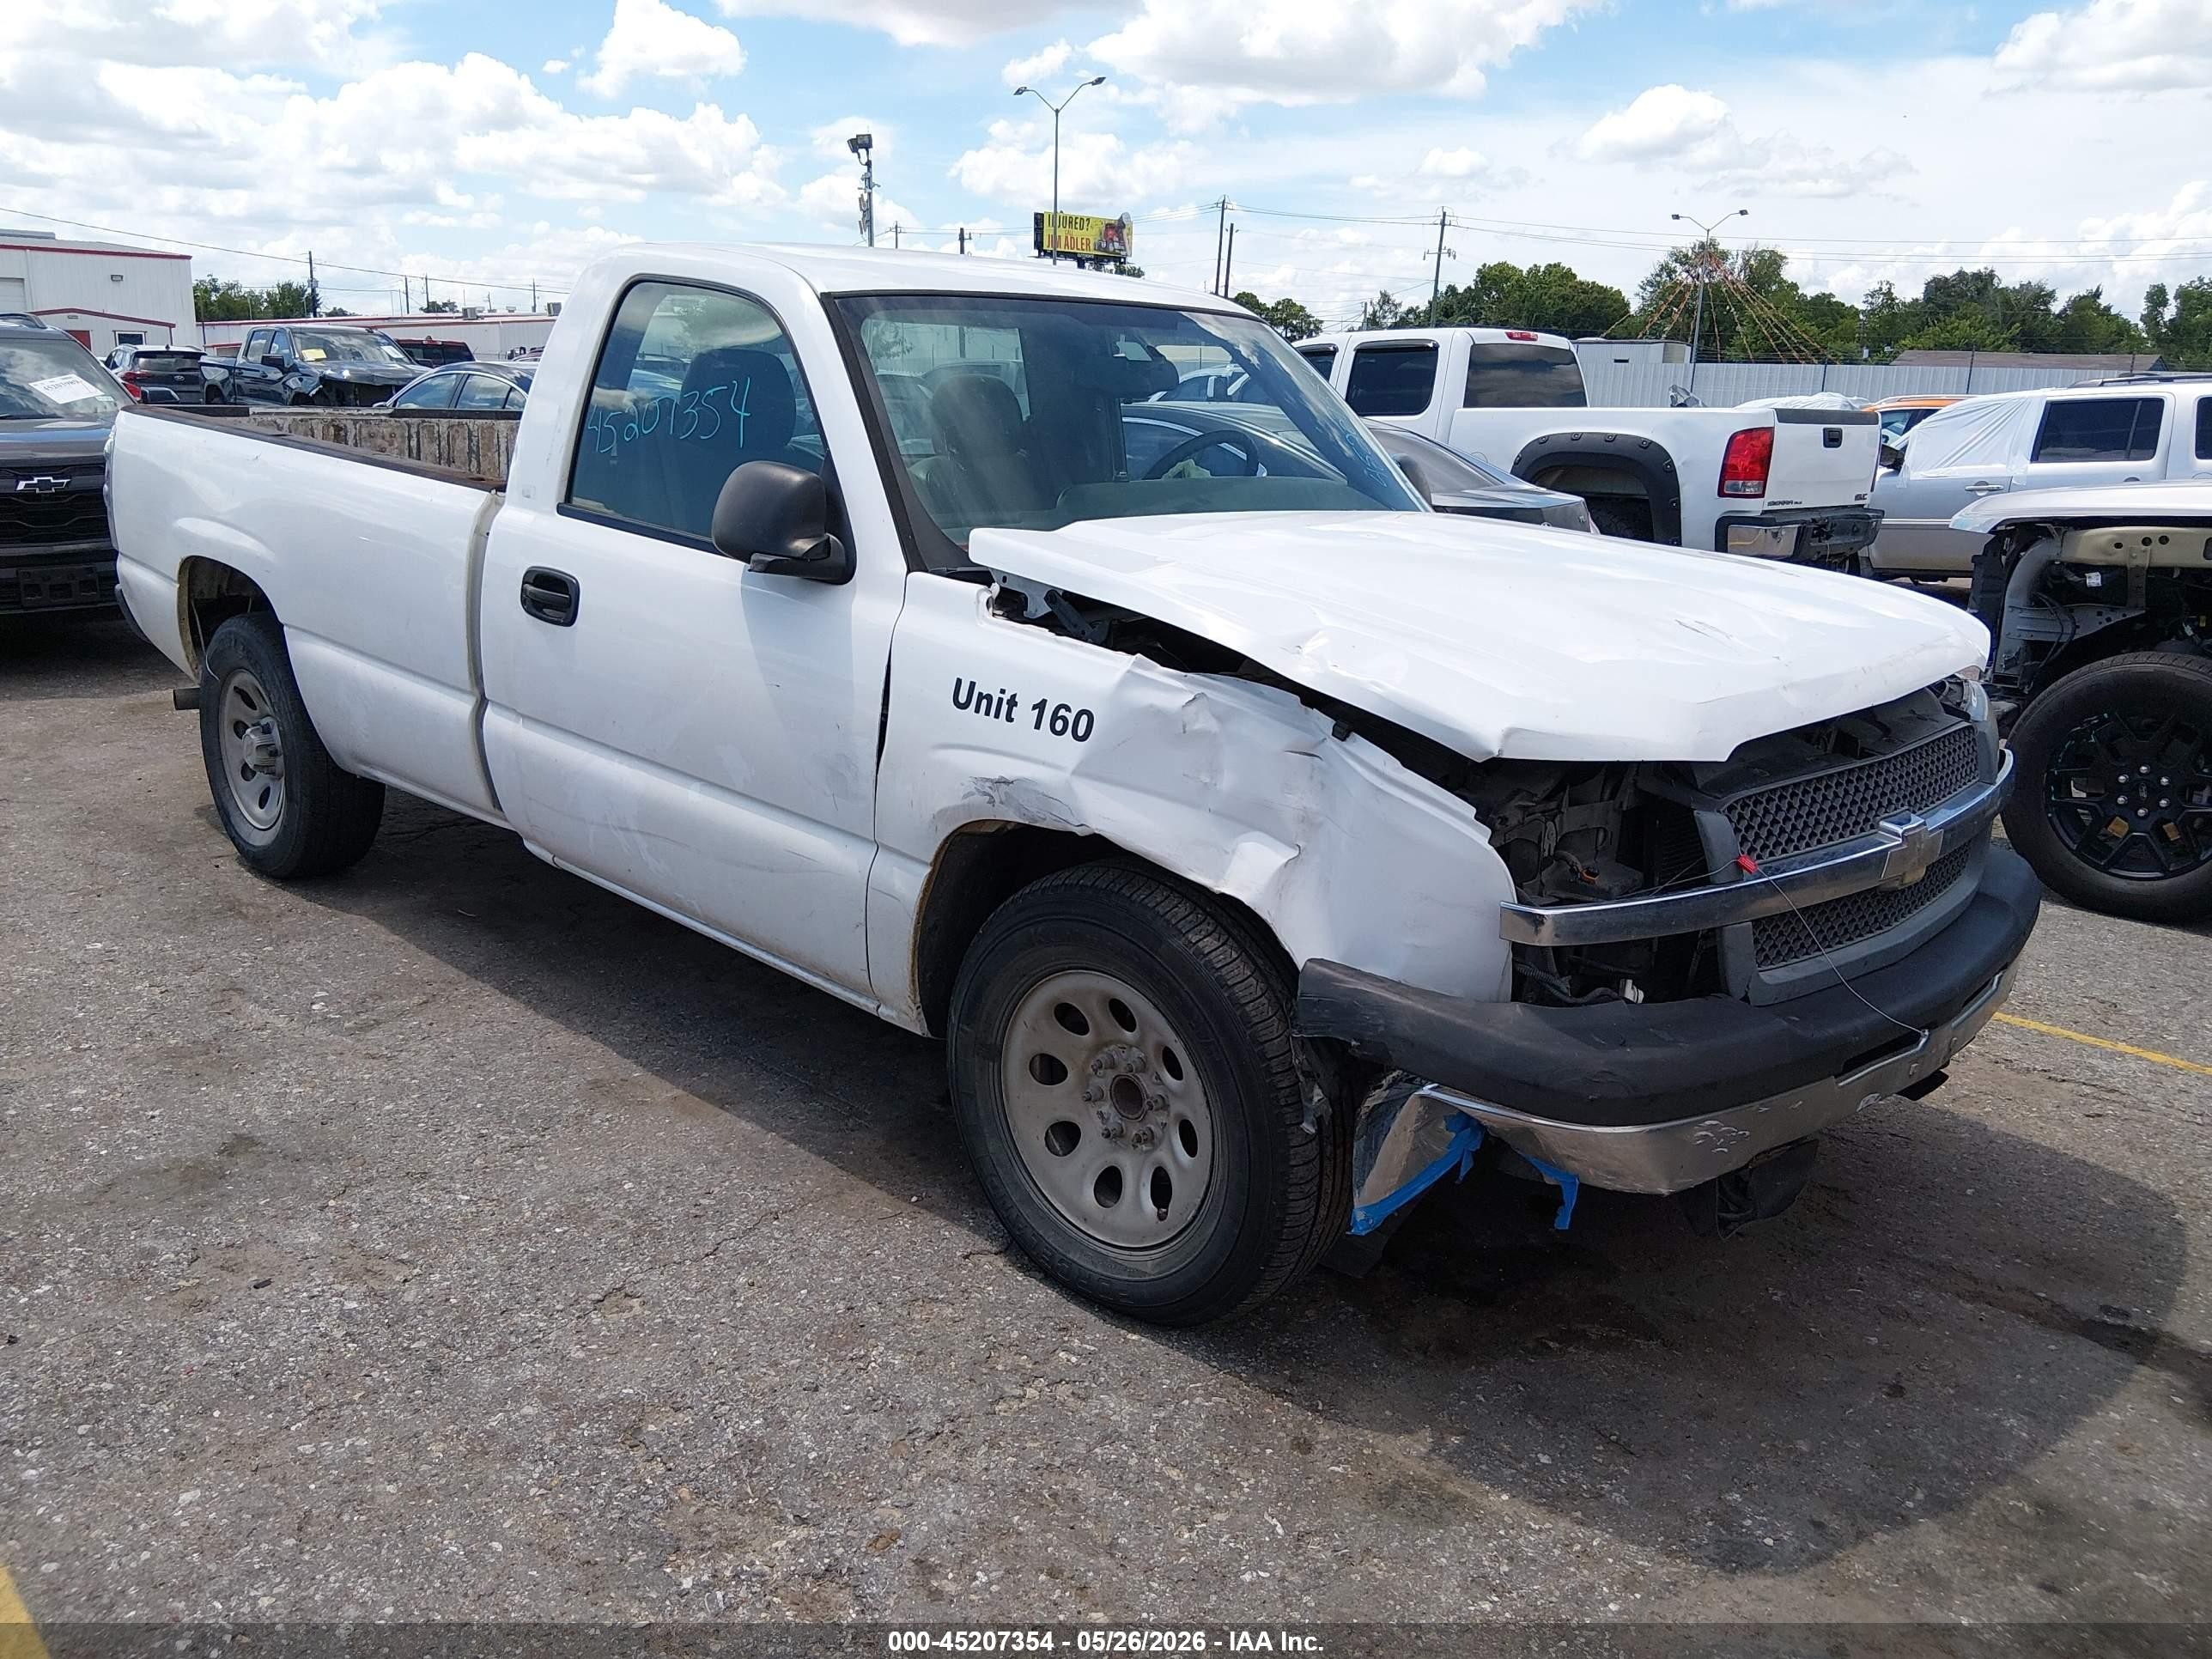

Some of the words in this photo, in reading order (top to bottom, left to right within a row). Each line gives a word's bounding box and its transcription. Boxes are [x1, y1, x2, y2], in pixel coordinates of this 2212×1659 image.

[1065, 235, 1091, 252] ADLER
[952, 677, 1018, 723] Unit
[1030, 697, 1095, 743] 160
